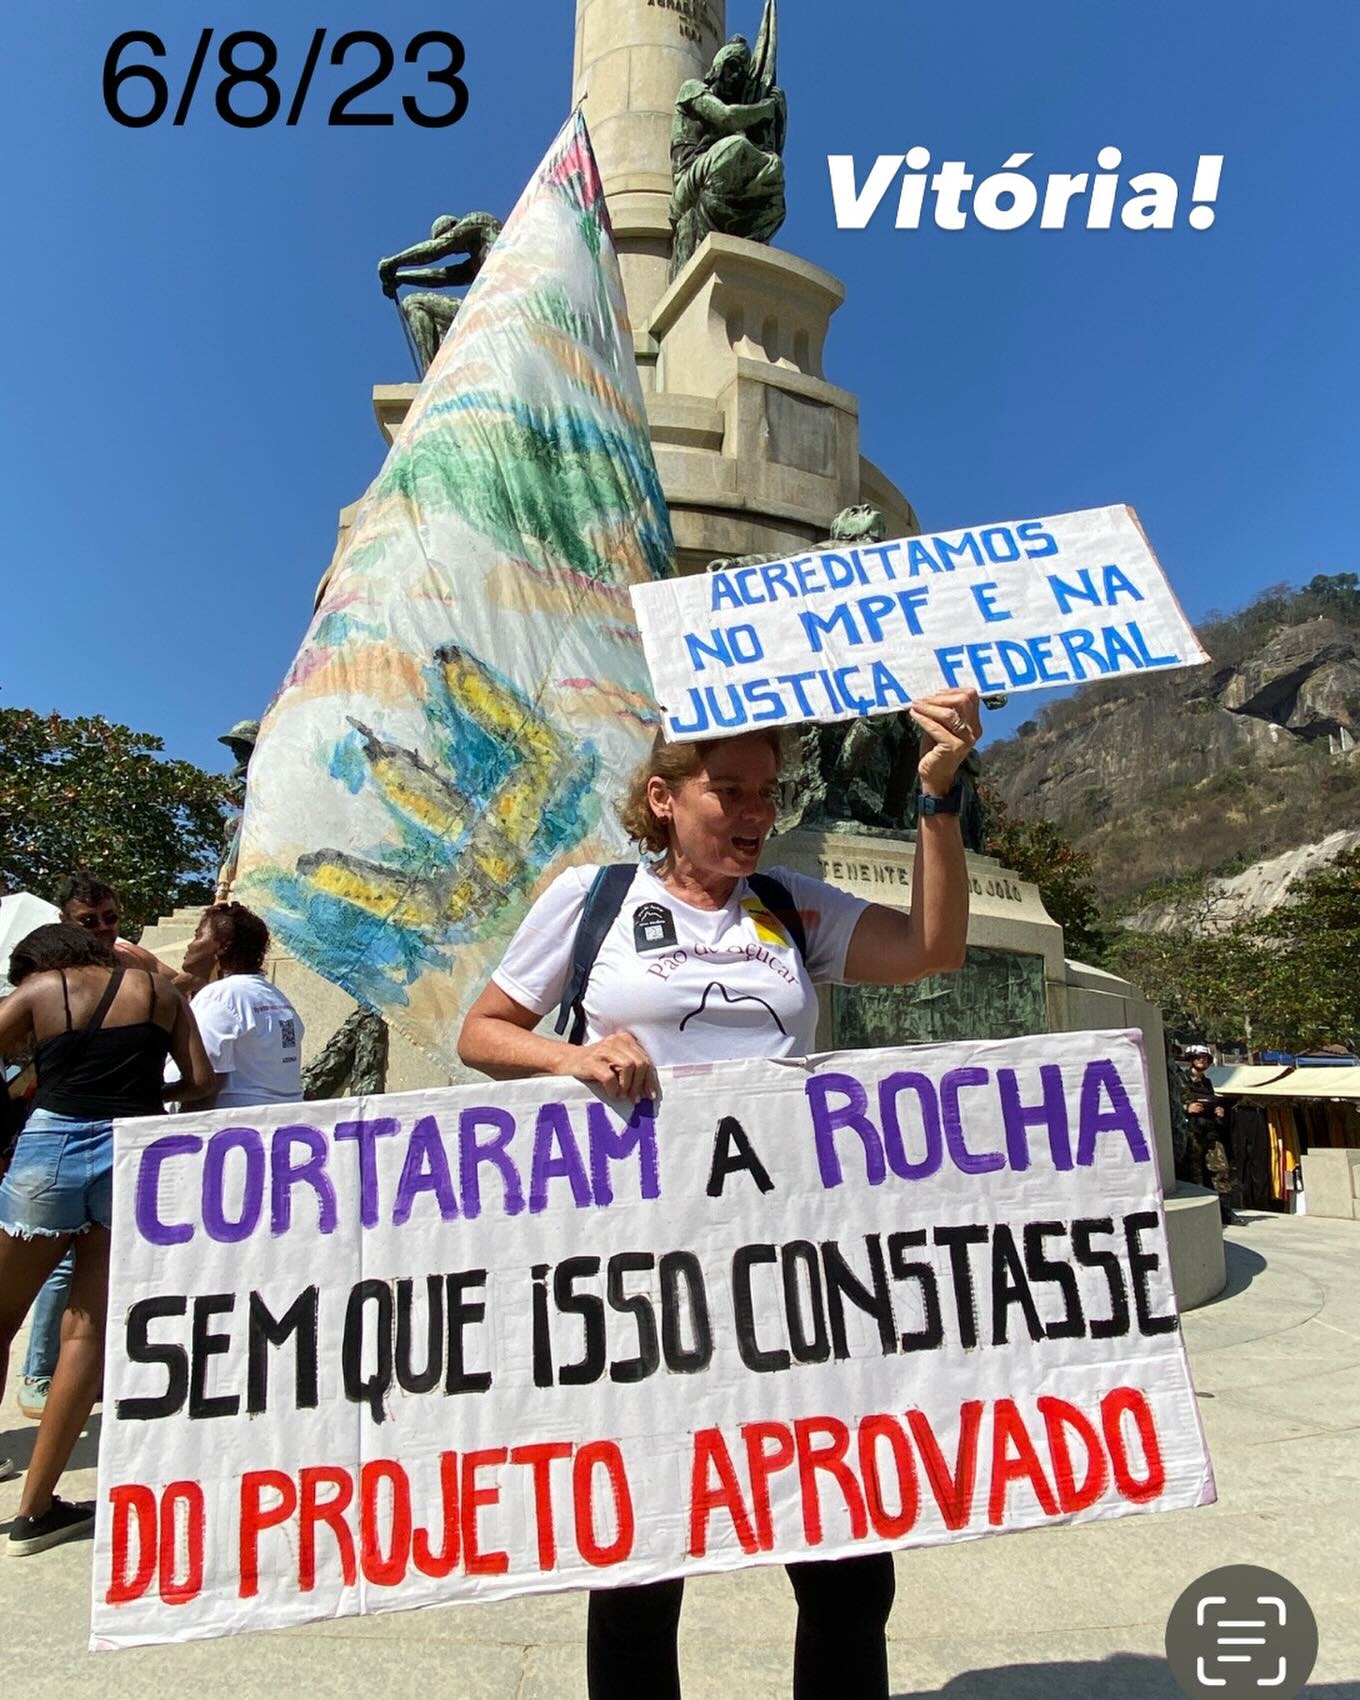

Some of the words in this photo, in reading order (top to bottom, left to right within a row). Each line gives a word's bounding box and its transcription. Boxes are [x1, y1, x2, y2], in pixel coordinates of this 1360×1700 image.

[684, 624, 763, 671] NO
[800, 586, 929, 652] MPF
[971, 582, 1011, 623] E
[1047, 564, 1144, 614] NA
[711, 522, 1059, 611] ACREDITAMOS
[670, 661, 909, 734] JUSTIÇA
[934, 622, 1181, 690] FEDERAL
[818, 860, 909, 887] TENENTE
[647, 949, 689, 982] Pão
[135, 1100, 662, 1246] CORTARAM
[706, 1116, 775, 1197] A
[805, 1058, 1150, 1189] ROCHA
[116, 1284, 320, 1421] SEM
[342, 1268, 493, 1425] QUE
[732, 1211, 1178, 1373] CONSTASSE
[105, 1481, 204, 1605] DO
[238, 1439, 634, 1598] PROJETO
[688, 1386, 1166, 1558] APROVADO
